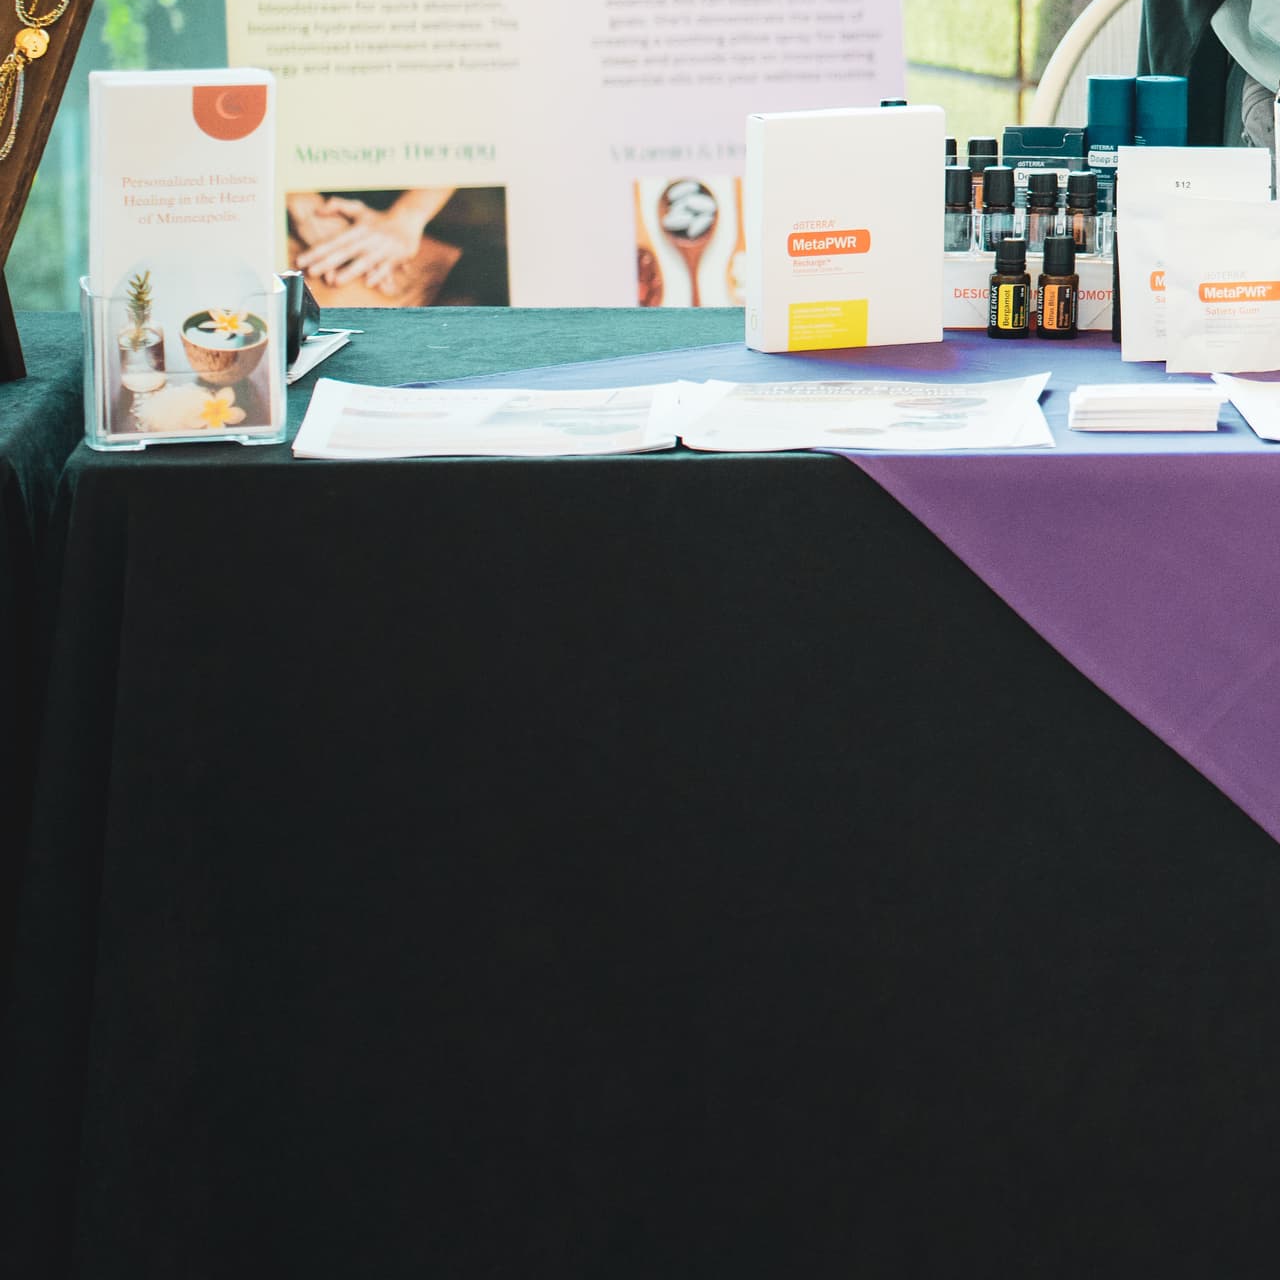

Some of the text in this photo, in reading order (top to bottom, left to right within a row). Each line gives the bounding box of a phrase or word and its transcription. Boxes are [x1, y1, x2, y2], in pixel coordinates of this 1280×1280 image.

[294, 143, 397, 168] Massage
[124, 192, 257, 209] Healing in the Heart
[138, 212, 154, 225] of
[792, 235, 858, 252] MetaPWR
[1001, 289, 1011, 327] Bergamot
